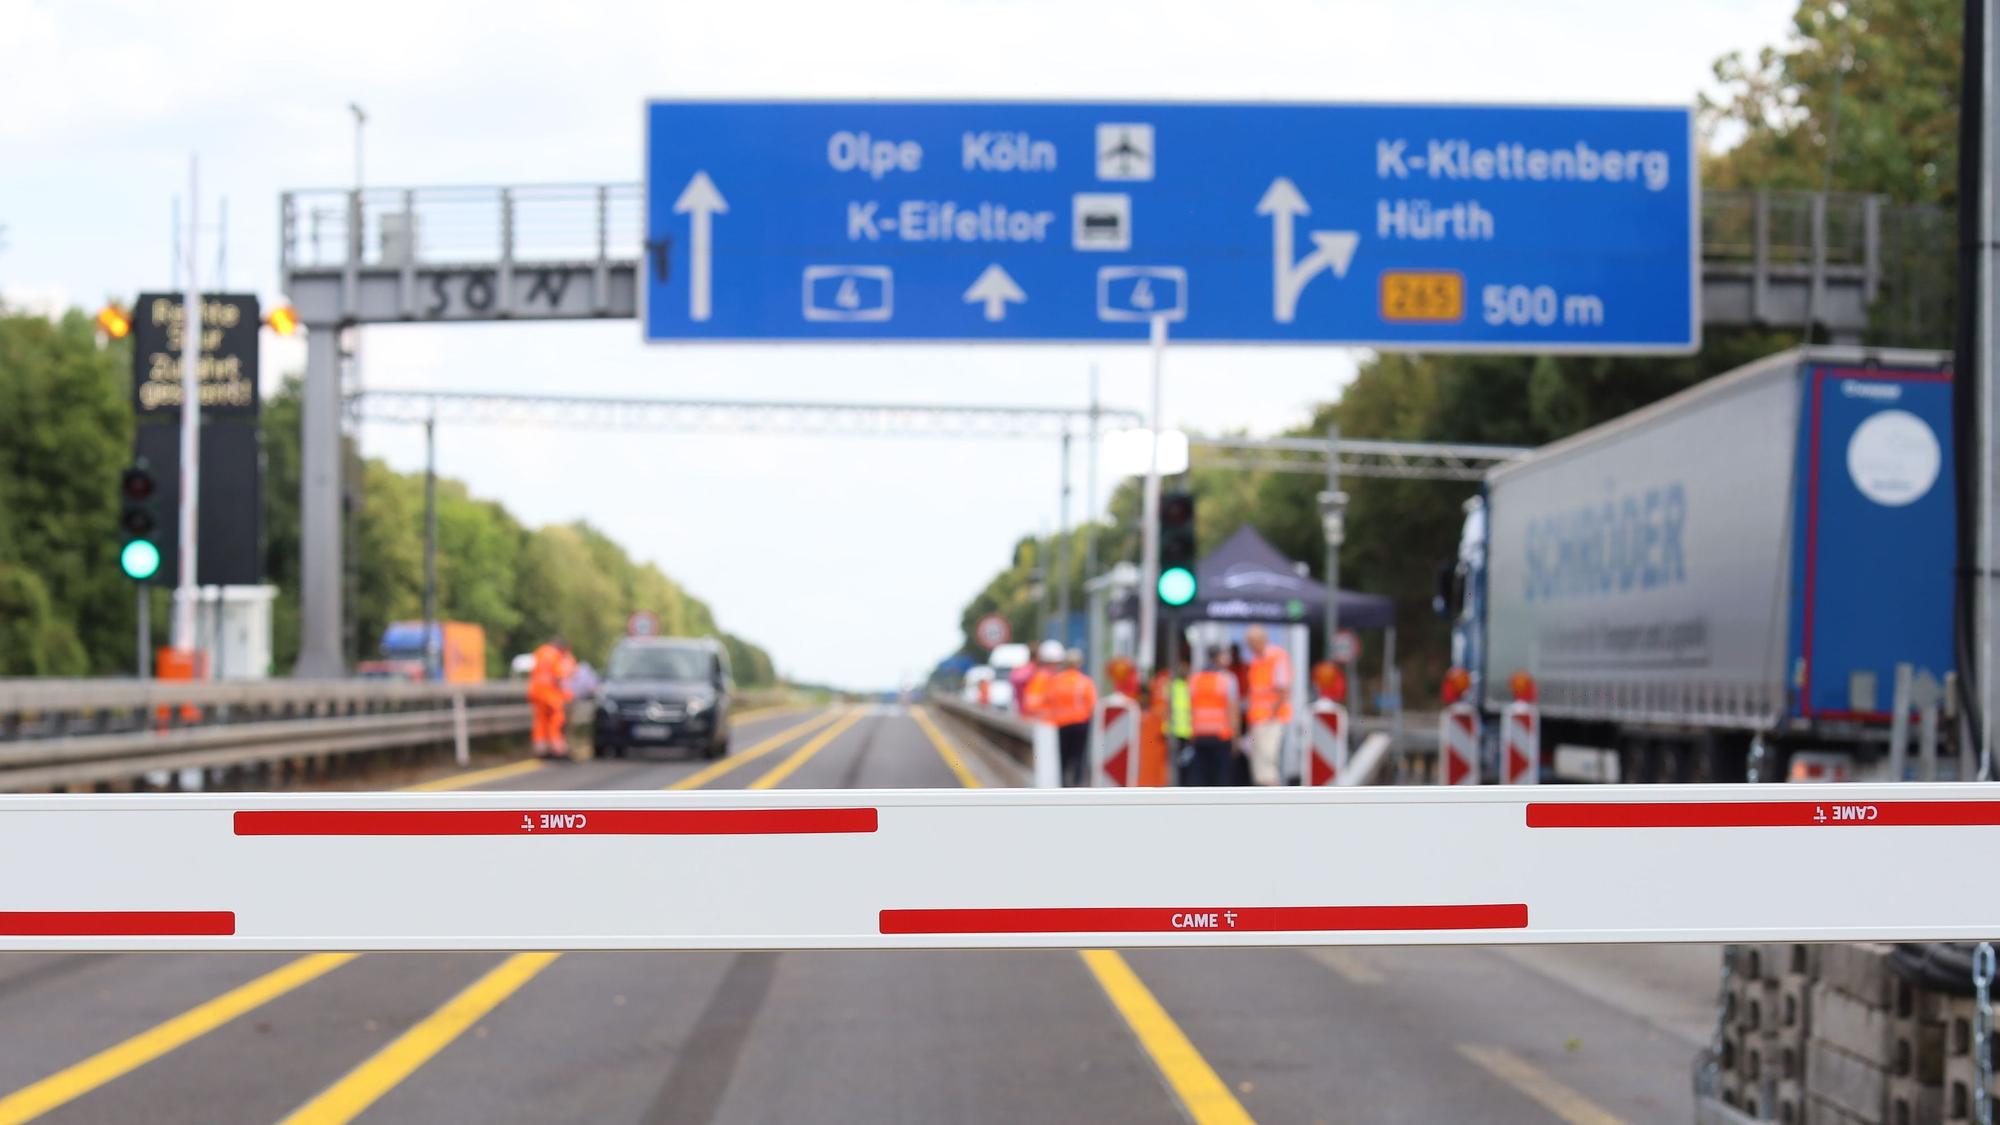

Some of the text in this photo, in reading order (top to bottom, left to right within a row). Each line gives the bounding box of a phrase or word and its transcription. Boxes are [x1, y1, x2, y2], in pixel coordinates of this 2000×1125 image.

[827, 131, 1057, 180] Olpe Köln
[1377, 139, 1669, 191] K-Klettenberg
[848, 201, 1054, 242] K-Eifeltor
[1377, 199, 1494, 239] Hürth
[835, 277, 861, 310] 4
[1130, 278, 1156, 310] 4
[1393, 276, 1450, 310] 265
[1483, 285, 1604, 326] 500 m
[540, 813, 587, 828] CAME
[1832, 805, 1878, 820] CAME
[1171, 913, 1219, 928] CAME
